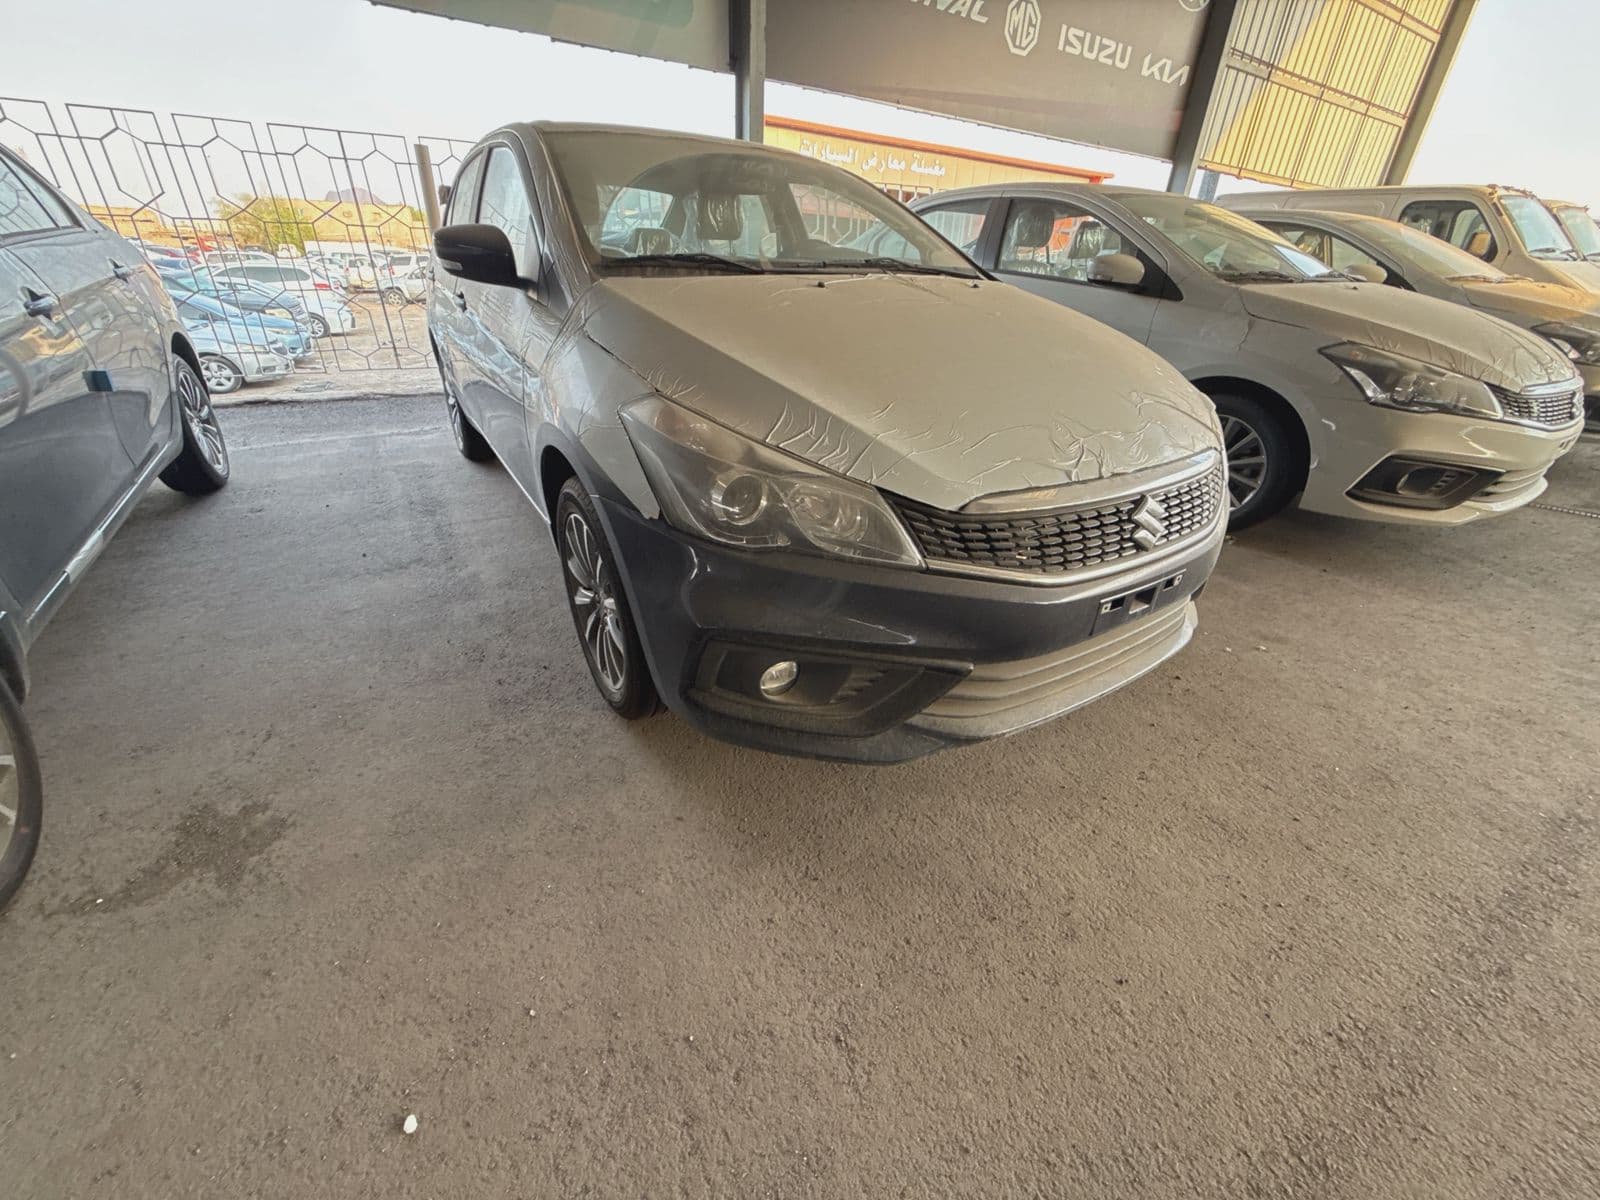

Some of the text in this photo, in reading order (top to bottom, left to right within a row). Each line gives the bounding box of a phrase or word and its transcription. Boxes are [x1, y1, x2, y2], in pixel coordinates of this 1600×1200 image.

[1007, 0, 1038, 49] MG
[1057, 23, 1133, 70] ISUZU
[862, 152, 906, 174] معارض
[910, 152, 945, 177] مغسلة
